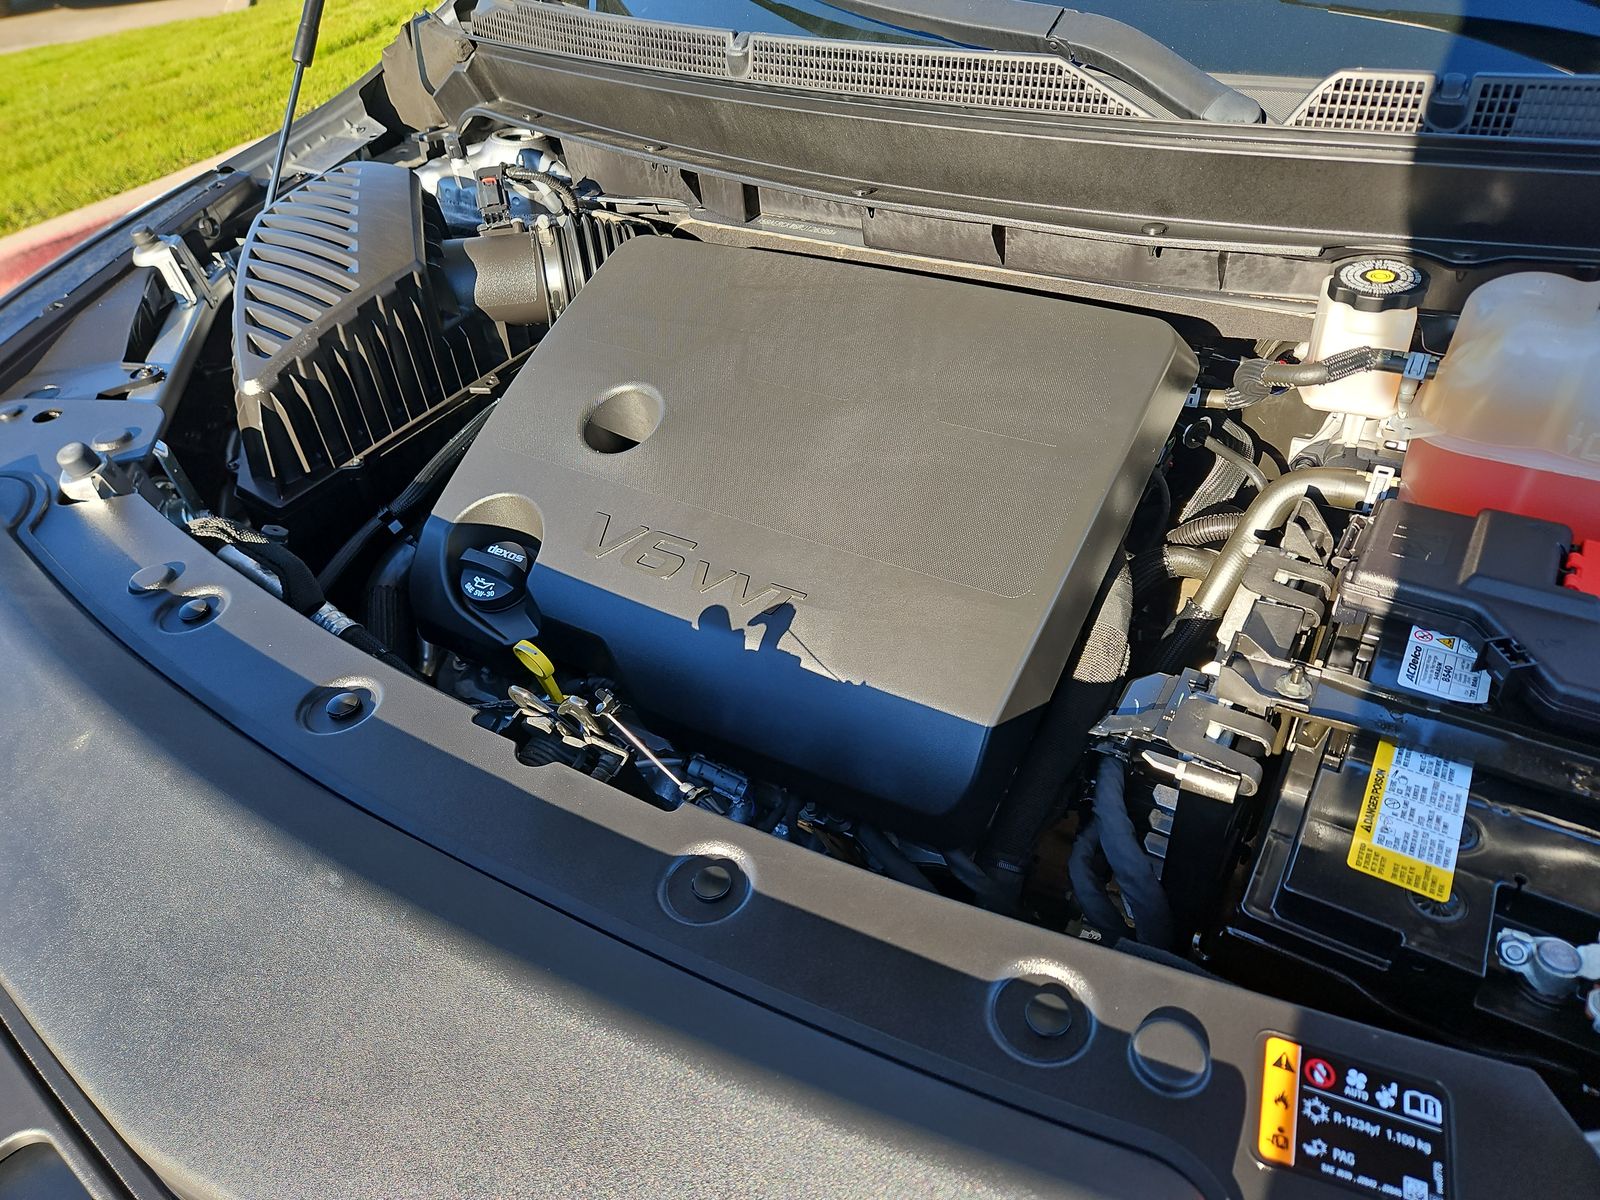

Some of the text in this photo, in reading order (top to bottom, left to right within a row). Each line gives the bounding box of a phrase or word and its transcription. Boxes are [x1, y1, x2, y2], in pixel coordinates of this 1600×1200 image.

[487, 544, 527, 563] dexos
[585, 511, 809, 616] V6 VVT
[1405, 645, 1423, 682] ACDelco
[1363, 768, 1387, 825] DANGER/POISON
[1344, 1086, 1369, 1102] AUTO
[1417, 1138, 1431, 1155] kg
[1332, 1147, 1355, 1166] PAG
